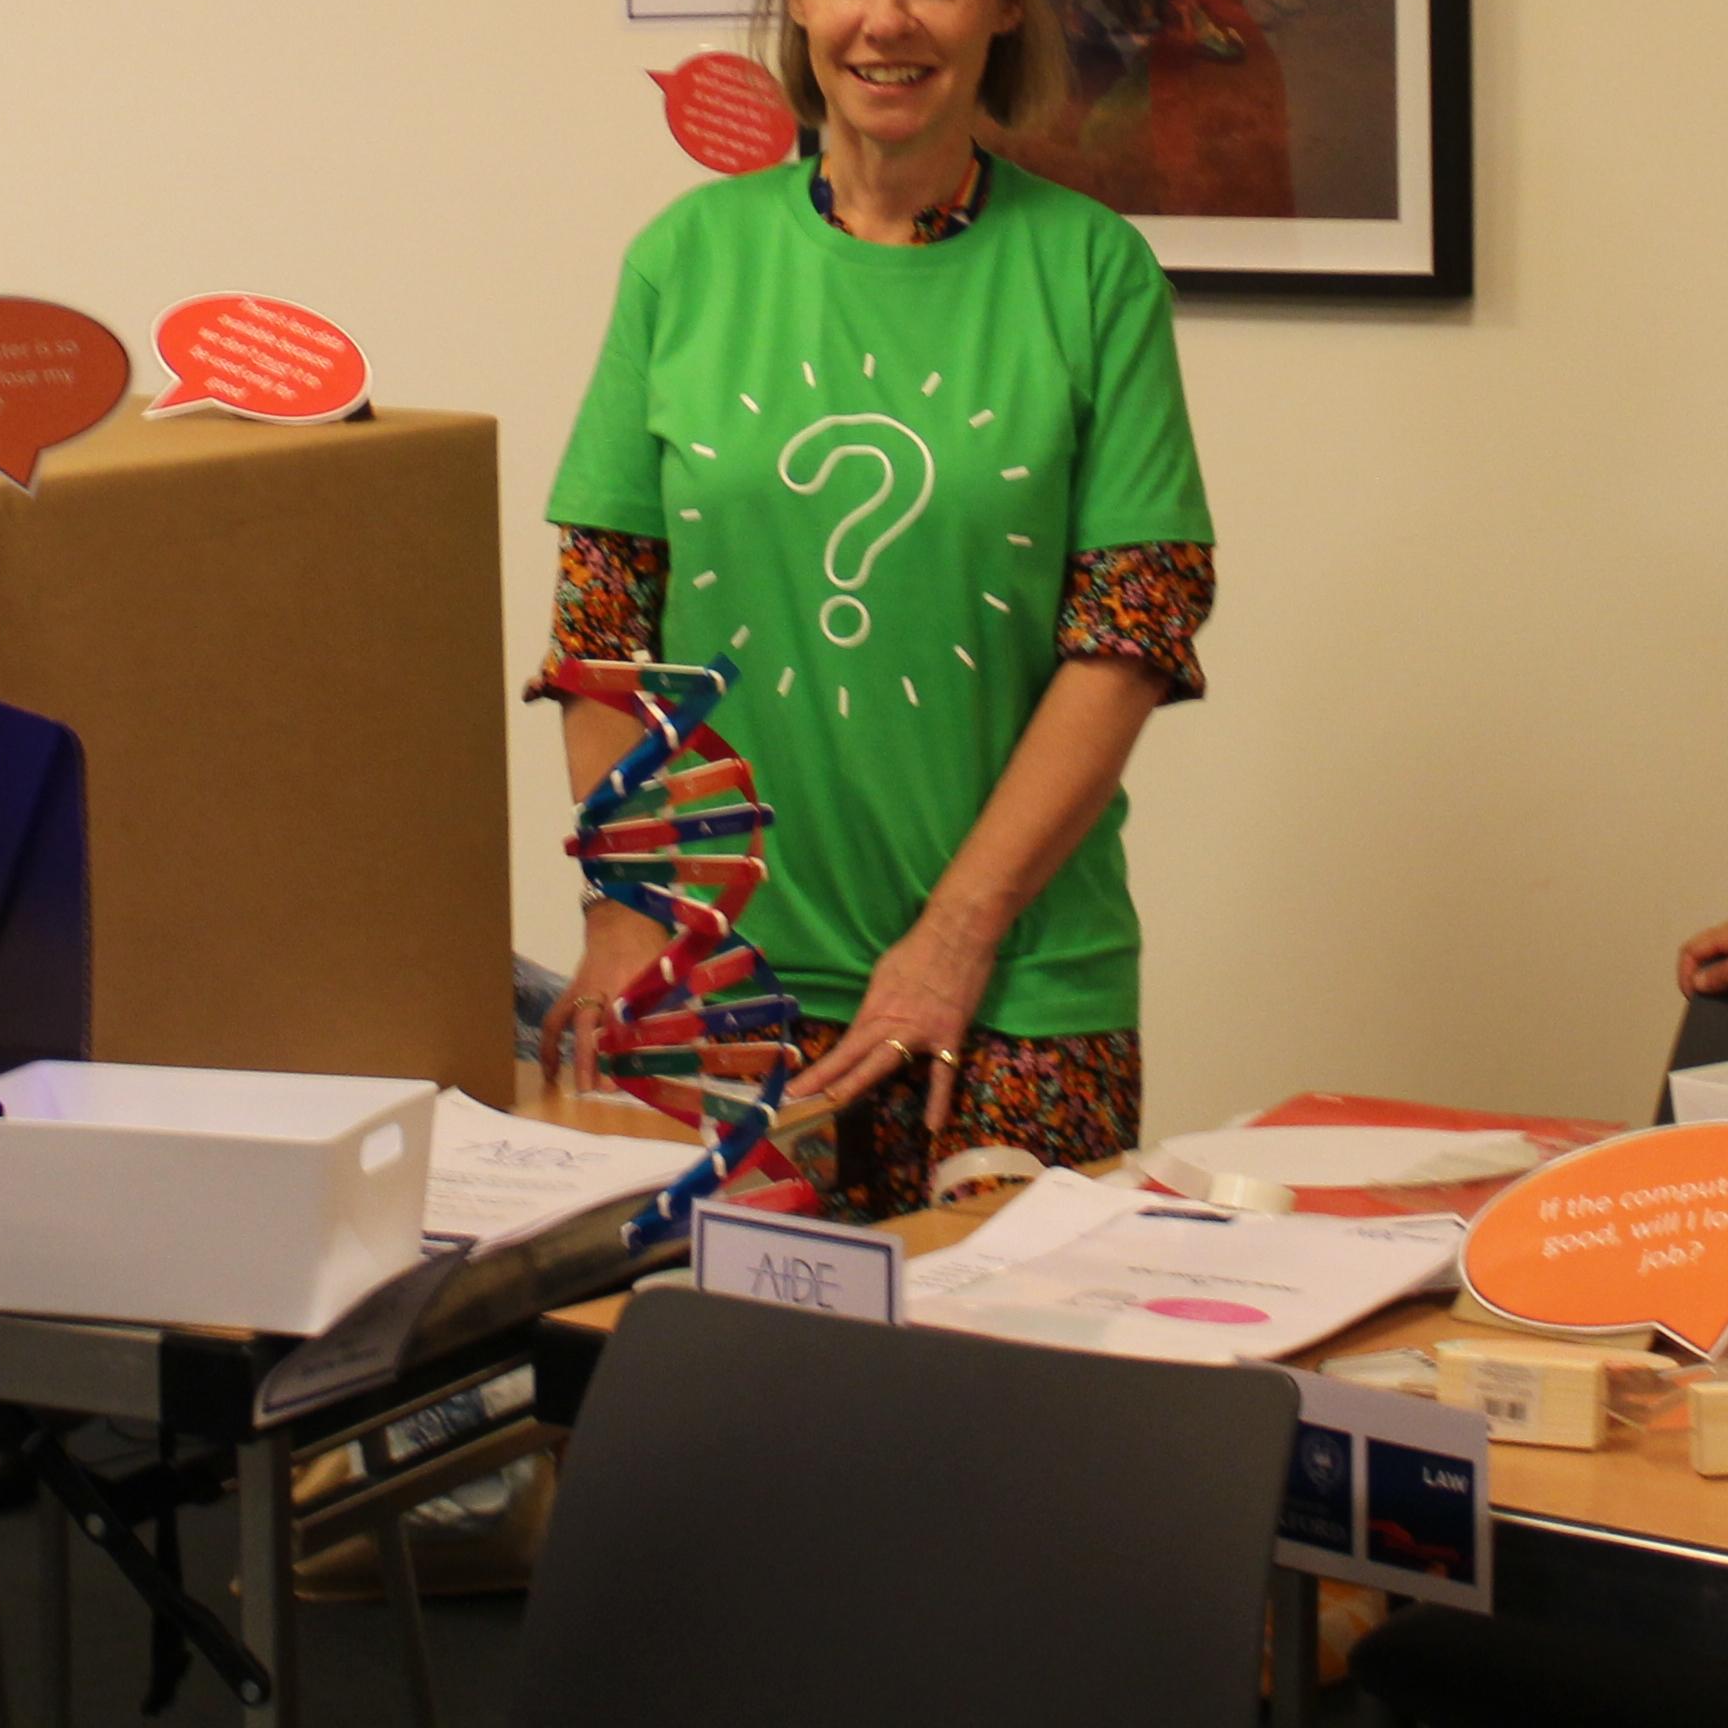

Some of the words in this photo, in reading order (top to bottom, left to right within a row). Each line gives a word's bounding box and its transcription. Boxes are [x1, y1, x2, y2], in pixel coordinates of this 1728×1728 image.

[34, 340, 50, 358] is
[54, 339, 80, 354] so
[42, 368, 75, 385] my
[1539, 1196, 1561, 1223] If
[1567, 1195, 1614, 1219] the
[1542, 1221, 1622, 1260] good,
[1630, 1211, 1681, 1240] will
[1686, 1209, 1697, 1232] I
[1636, 1240, 1706, 1277] job?
[746, 1252, 843, 1309] AIDE
[1421, 1464, 1470, 1495] LAW
